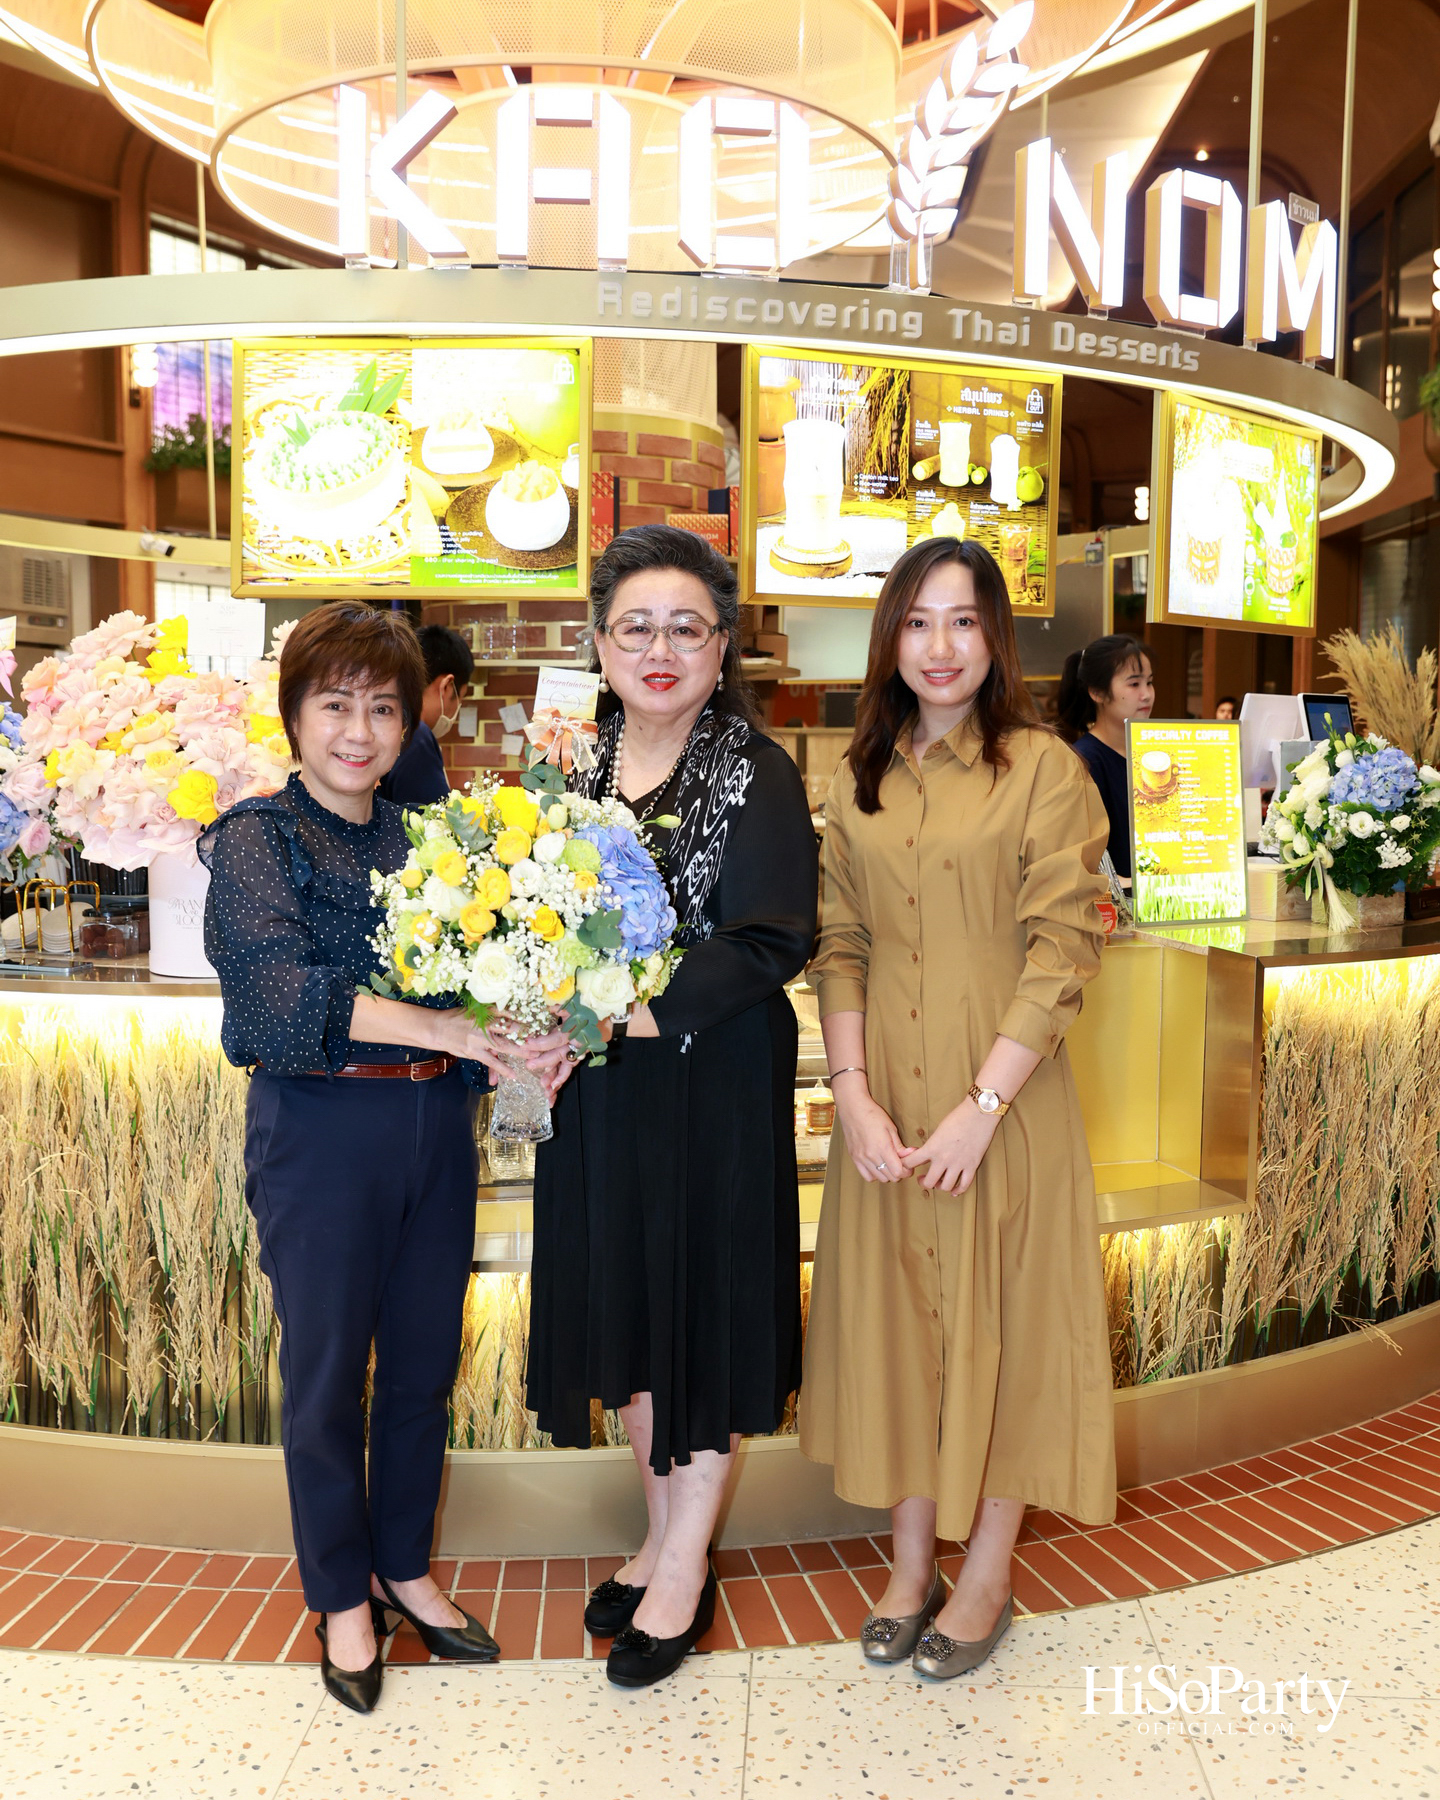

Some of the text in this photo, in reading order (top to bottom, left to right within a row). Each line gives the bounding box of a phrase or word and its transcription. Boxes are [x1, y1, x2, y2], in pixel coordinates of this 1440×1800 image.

[339, 84, 1338, 360] KAO NOM
[597, 281, 1201, 372] Rediscovering Thai Desserts
[960, 387, 1003, 407] สมุนไพร
[953, 405, 1009, 418] HERBAL DRINKS
[1141, 730, 1230, 741] SPECIALTY COFFEE
[1144, 831, 1183, 843] HERBAL
